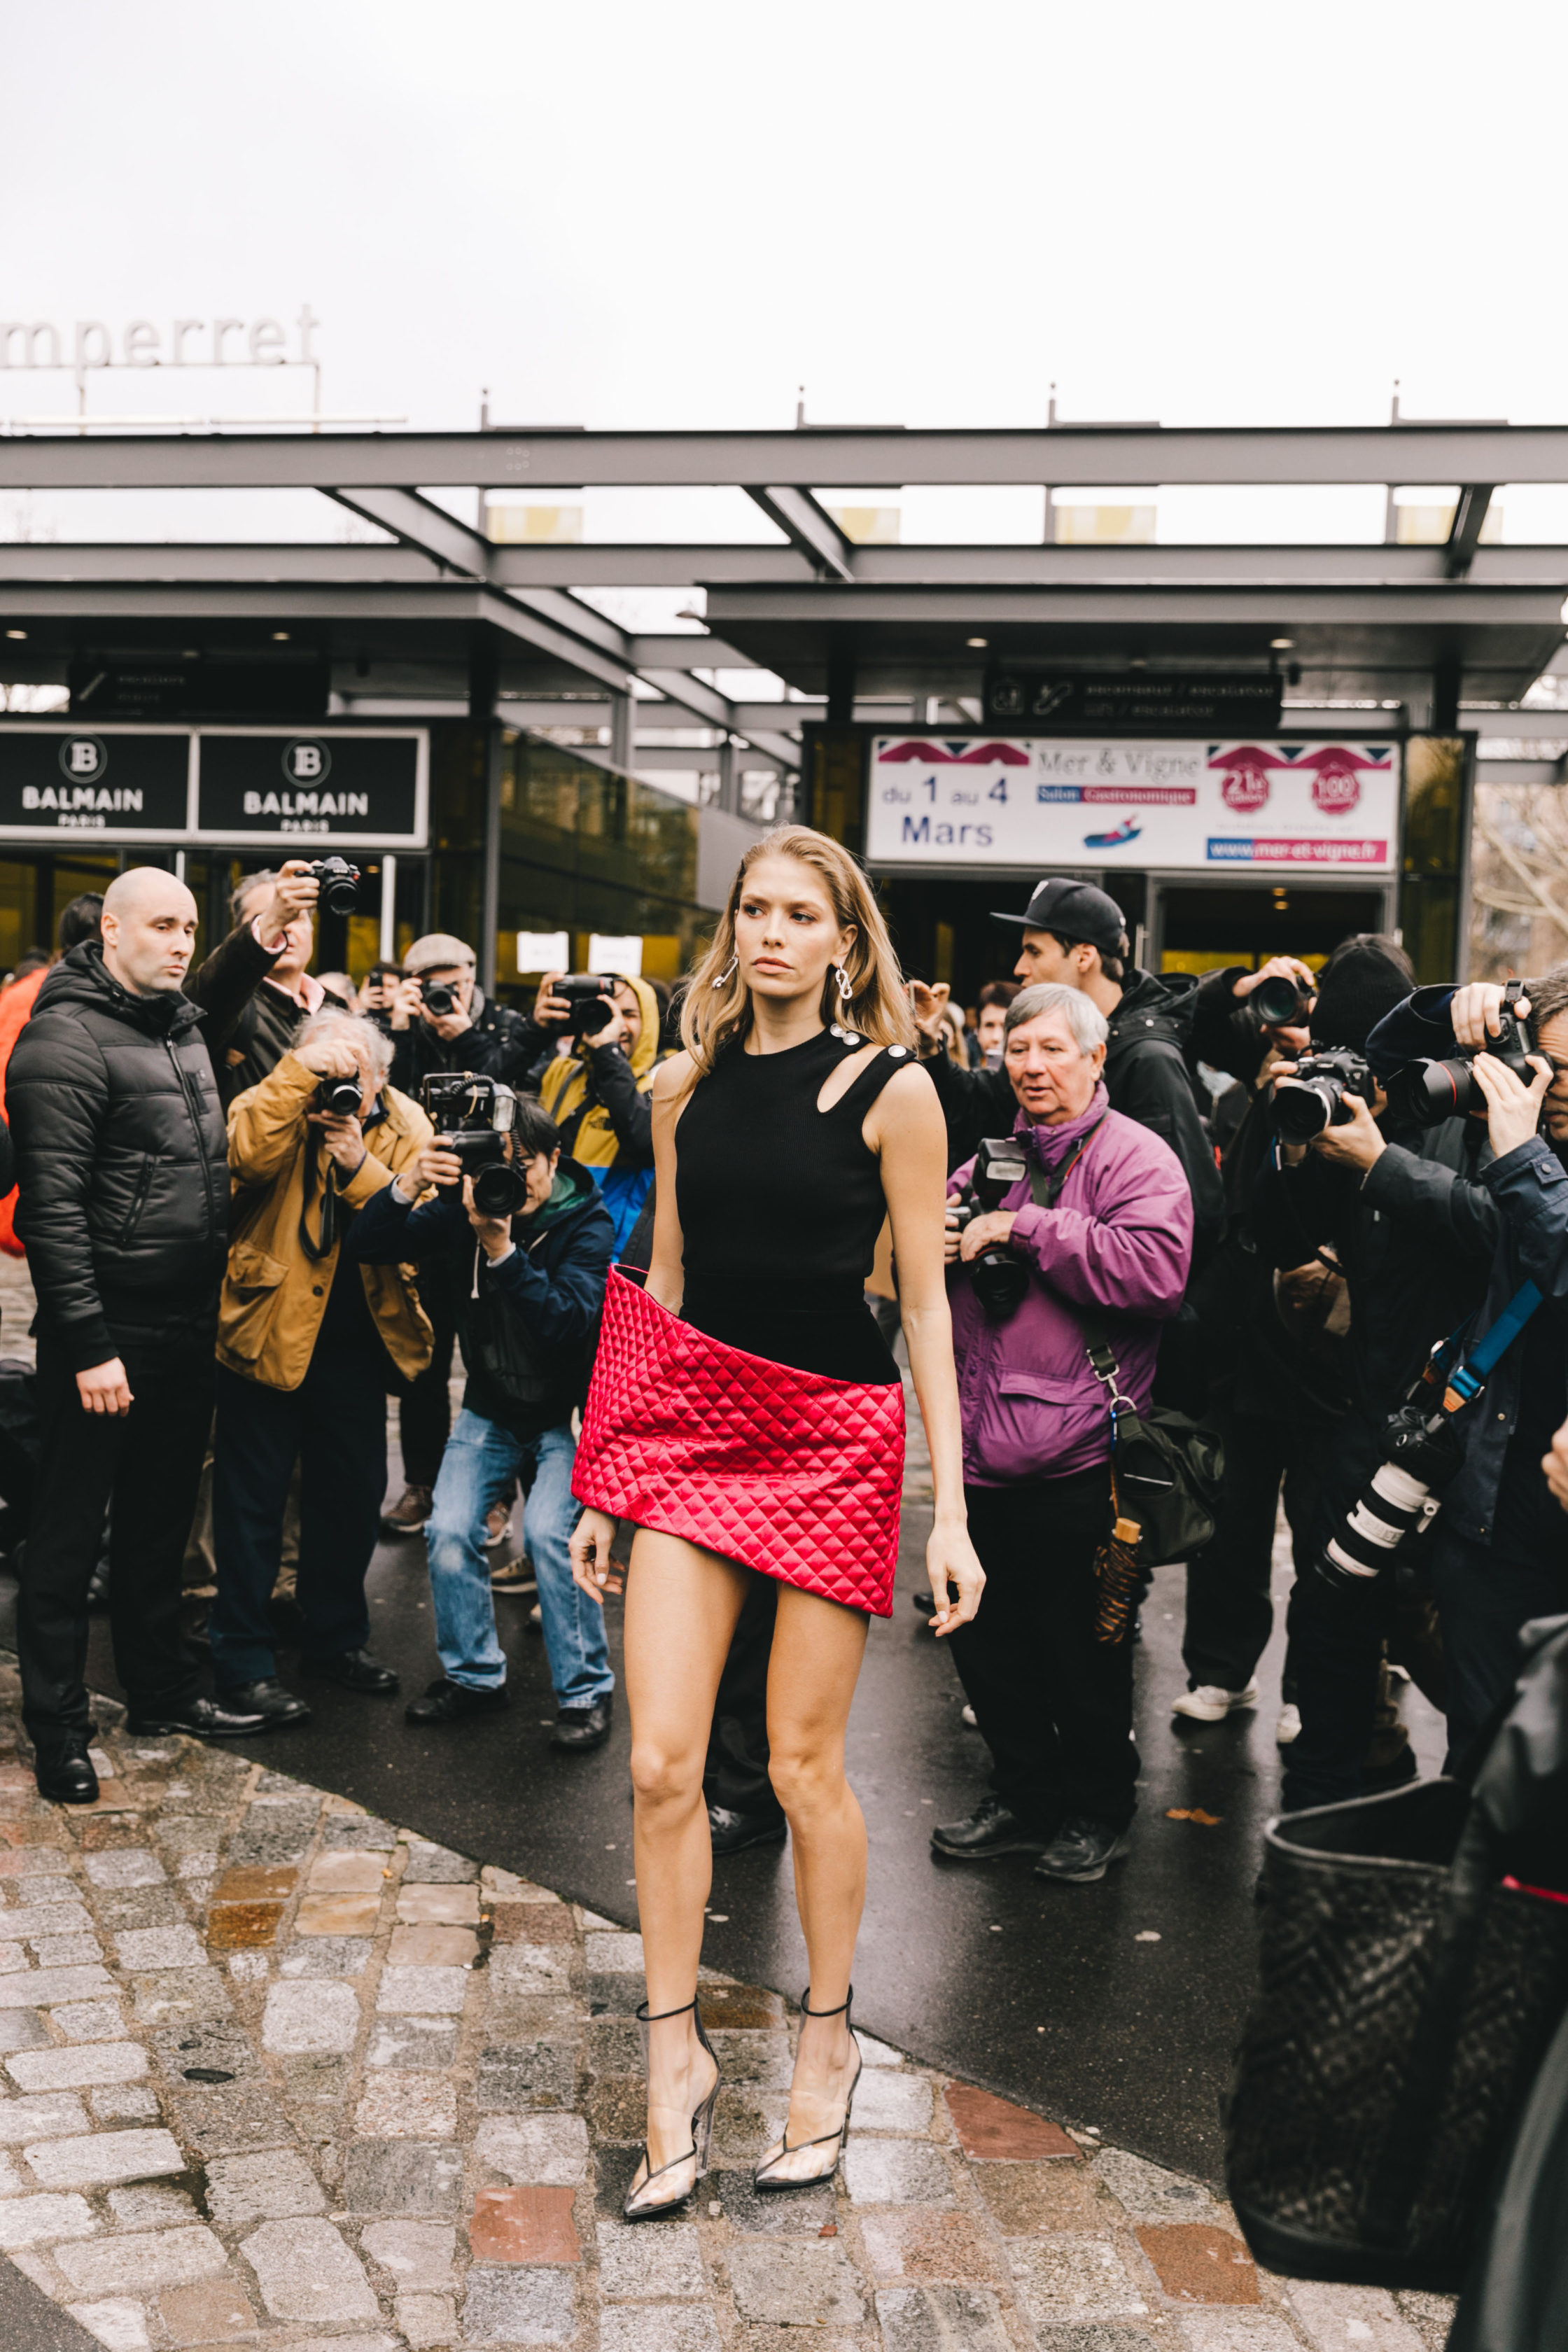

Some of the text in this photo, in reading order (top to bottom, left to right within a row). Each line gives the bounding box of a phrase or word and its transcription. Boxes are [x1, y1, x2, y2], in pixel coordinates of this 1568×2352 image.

[70, 741, 98, 772] B
[294, 746, 322, 776] B
[1039, 749, 1199, 783] Mer & Vigne
[22, 785, 144, 812] BALMAIN
[883, 776, 1008, 804] du 1 au 4
[1039, 788, 1191, 804] Salon Gastronomique
[1317, 776, 1354, 797] 100
[243, 790, 368, 816] BALMAIN
[57, 813, 106, 828] PARIS
[280, 819, 329, 832] PARIS
[902, 816, 993, 846] Mars
